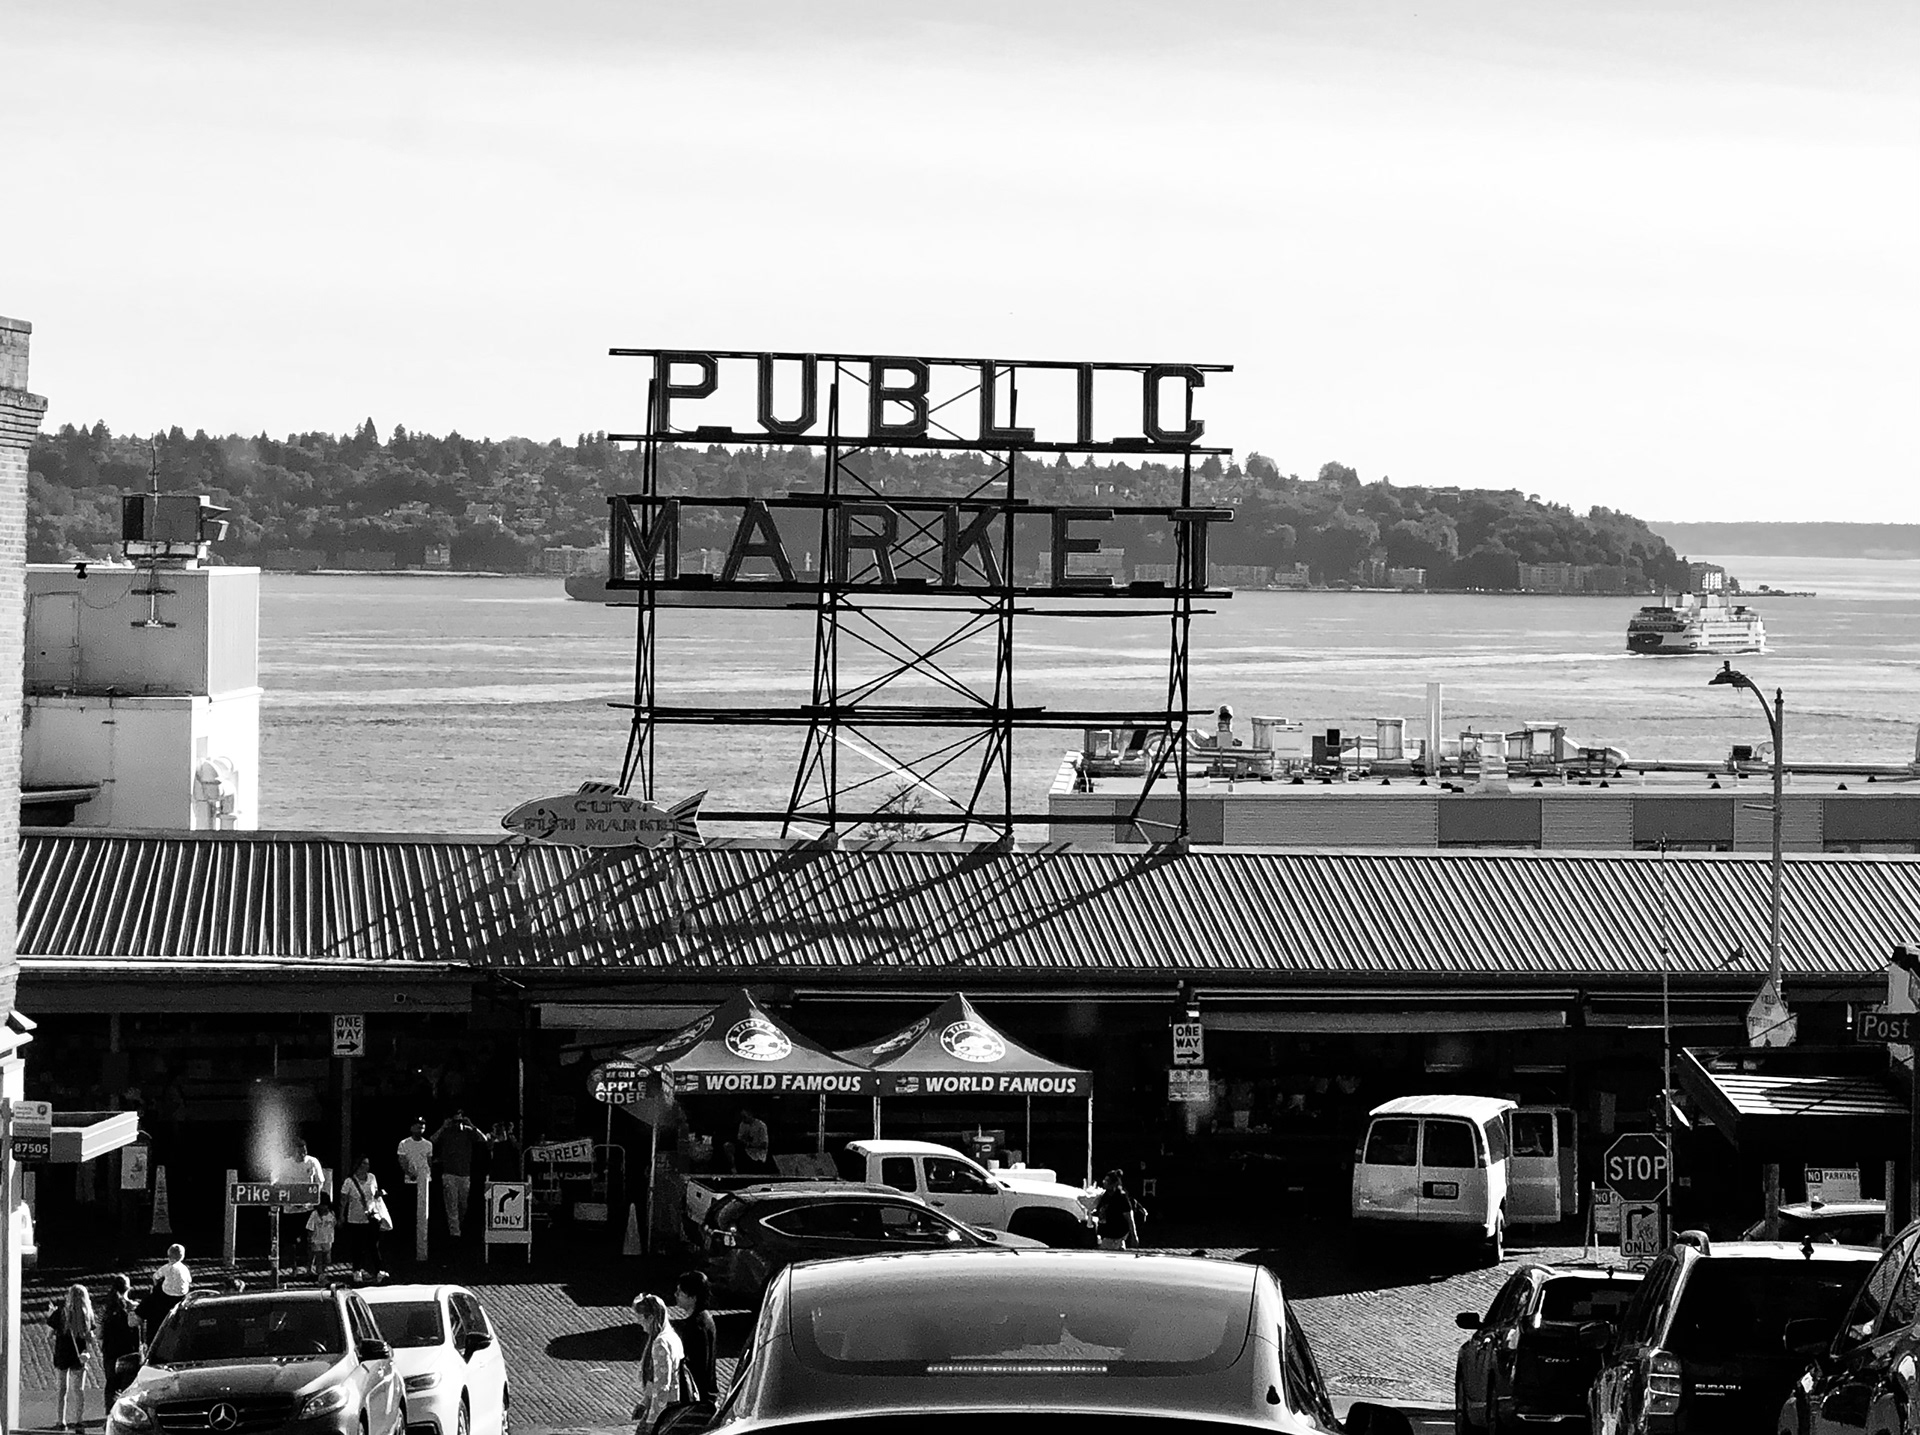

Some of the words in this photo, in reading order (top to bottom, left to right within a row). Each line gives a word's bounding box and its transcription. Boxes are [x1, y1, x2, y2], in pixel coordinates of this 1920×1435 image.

[655, 351, 1206, 445] PUBLIC
[608, 499, 1235, 591] MARKET
[574, 800, 637, 813] CITY
[523, 818, 577, 832] FISH
[585, 818, 679, 832] MARKET
[336, 1017, 361, 1028] ONE
[1864, 1015, 1909, 1039] Post
[336, 1029, 361, 1040] WAY
[1176, 1026, 1200, 1037] ONE
[1175, 1038, 1200, 1048] WAY
[595, 1081, 647, 1092] APPLE
[705, 1075, 776, 1091] WORLD
[781, 1075, 861, 1091] FAMOUS
[925, 1077, 995, 1092] WORLD
[999, 1077, 1076, 1093] FAMOUS
[595, 1092, 647, 1104] CIDER
[14, 1143, 48, 1154] 87505
[538, 1144, 587, 1161] STREET
[1610, 1156, 1667, 1180] STOP
[1808, 1171, 1821, 1181] NO
[1824, 1172, 1857, 1180] PARKING
[236, 1185, 270, 1202] Pike
[1595, 1192, 1609, 1203] NO
[494, 1215, 521, 1225] ONLY
[1624, 1241, 1657, 1254] ONLY
